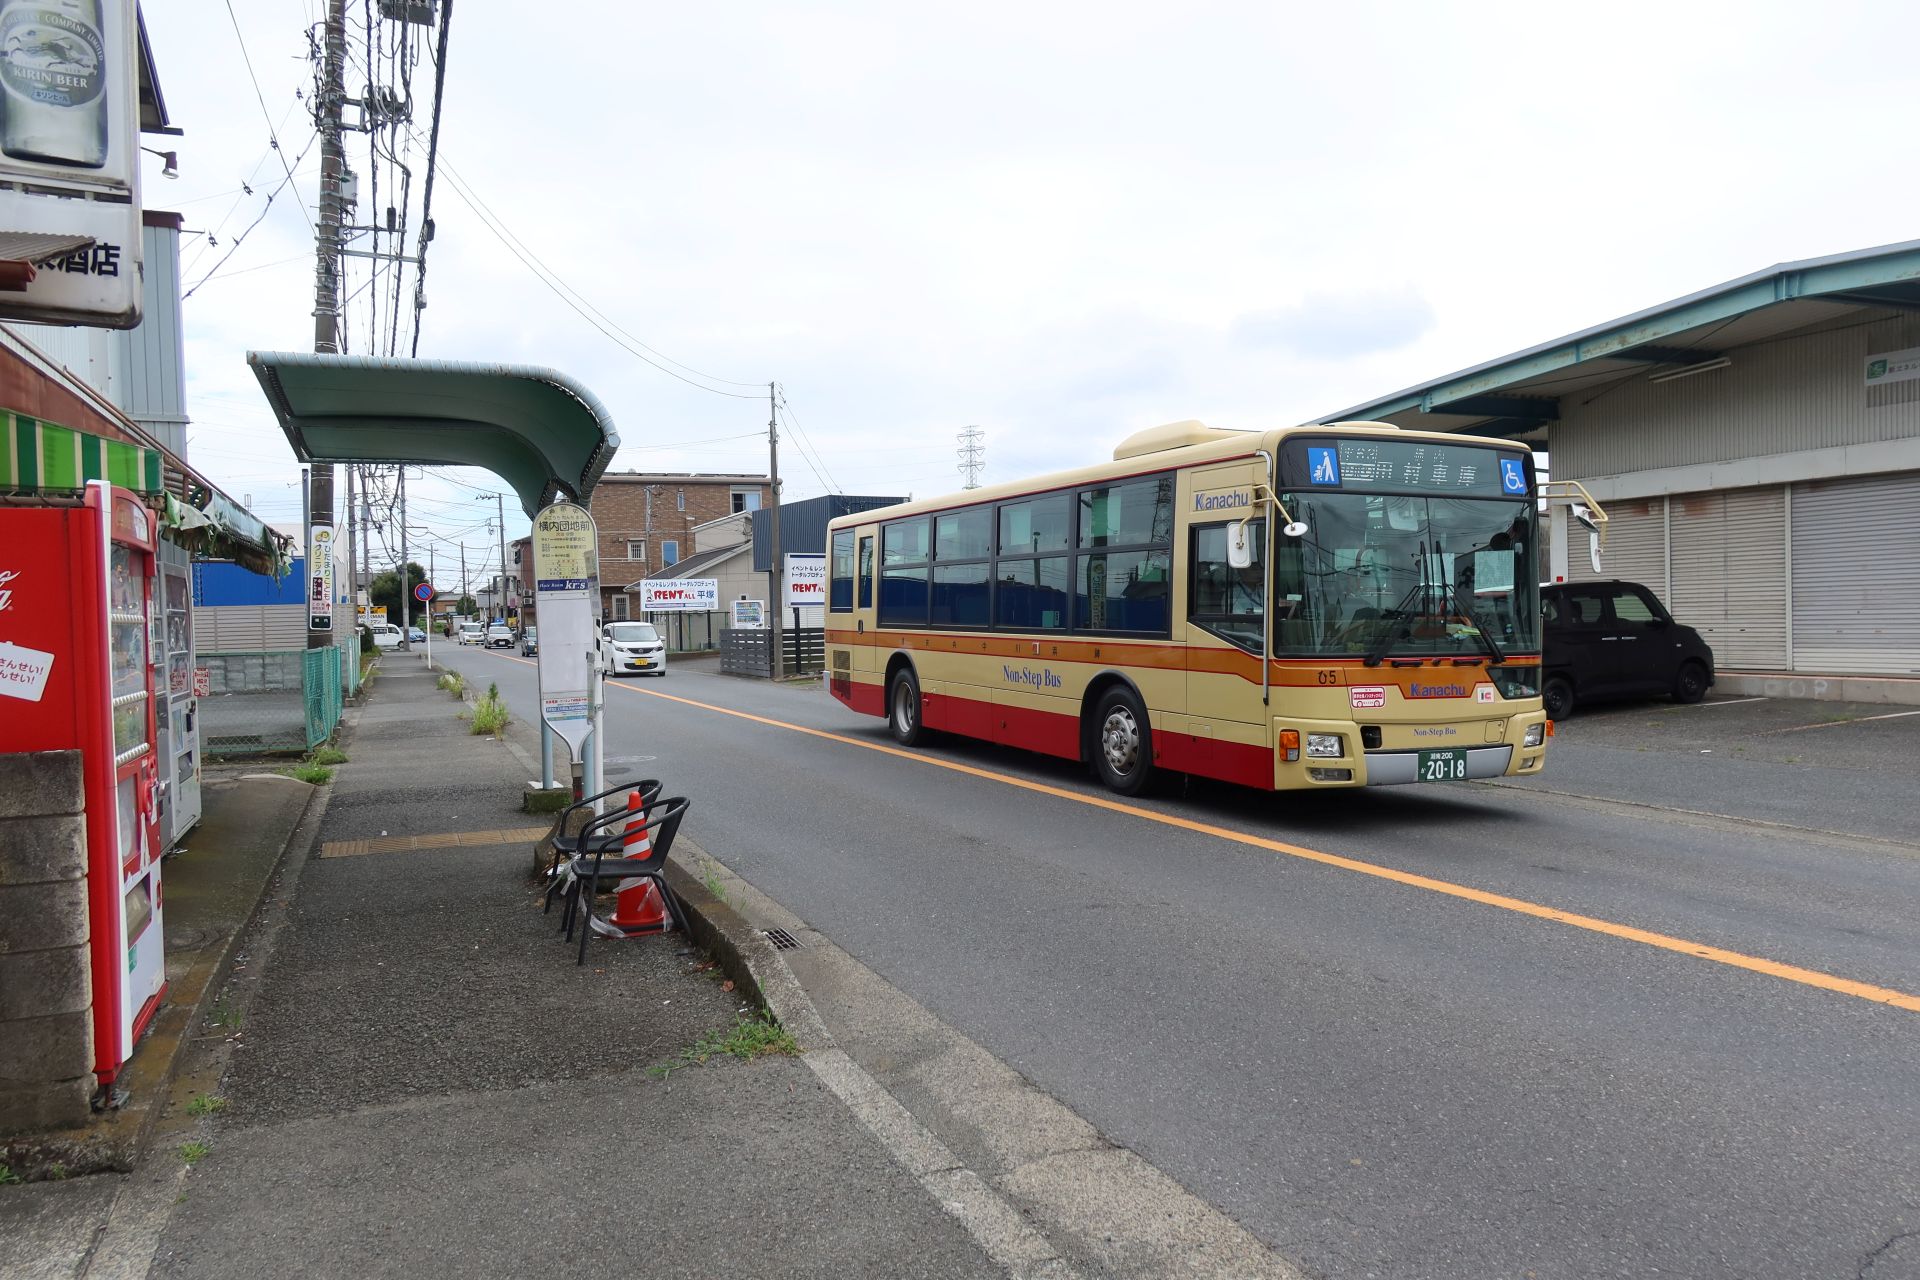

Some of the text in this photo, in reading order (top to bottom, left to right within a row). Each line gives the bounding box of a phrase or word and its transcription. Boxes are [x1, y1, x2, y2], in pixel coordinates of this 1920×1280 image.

[45, 15, 87, 35] COMPANY
[86, 34, 104, 61] LIMITED
[14, 66, 52, 82] KIRIN
[57, 74, 88, 88] BEER
[37, 242, 121, 277] 酒店
[1195, 490, 1249, 511] Kanachu
[539, 520, 590, 532] 横内団地前
[314, 543, 322, 577] クリニック
[324, 545, 332, 601] ひだまりこども
[653, 590, 684, 600] RENT
[697, 590, 715, 599] 平塚
[792, 583, 818, 593] RENT
[1003, 665, 1062, 690] Non-Step Bus
[1410, 683, 1466, 697] Kanachu
[1413, 727, 1457, 737] Non-Step Bus
[1441, 752, 1453, 760] 200
[1426, 760, 1465, 780] 20-18
